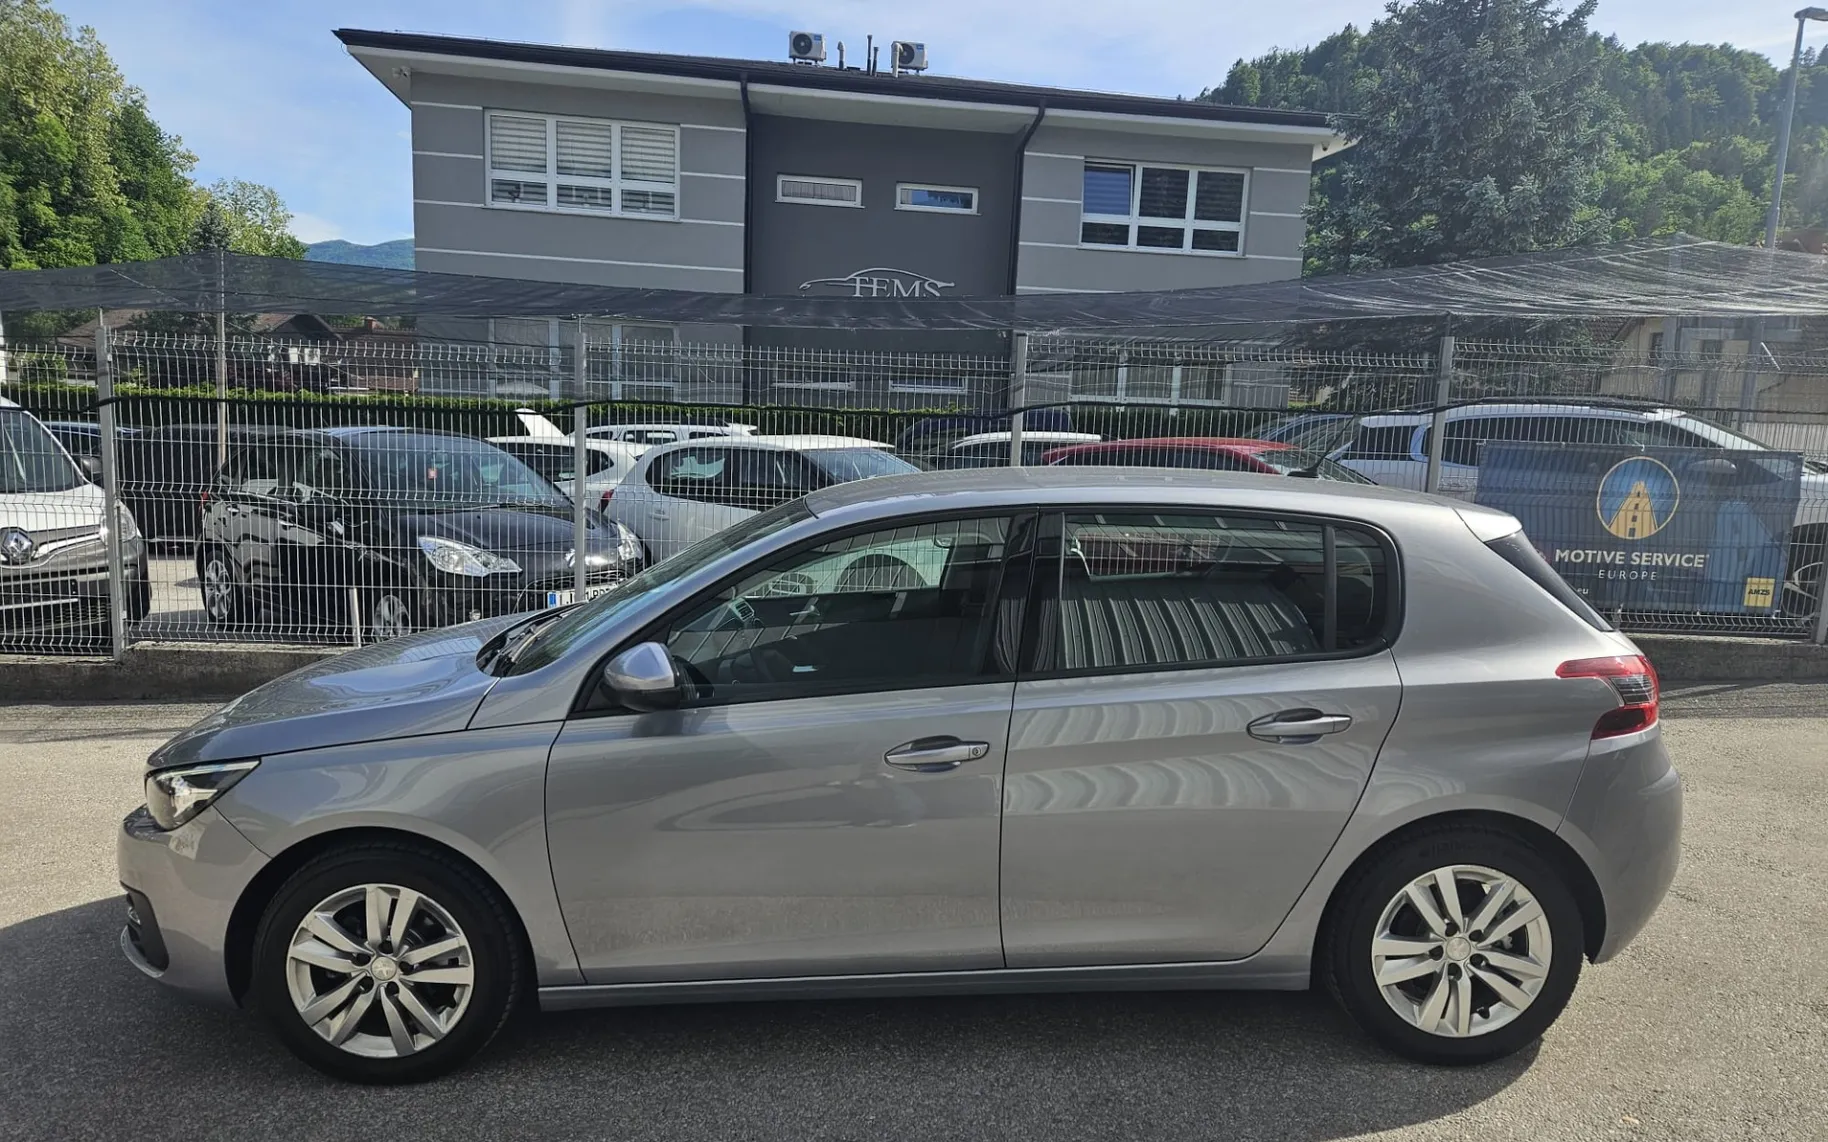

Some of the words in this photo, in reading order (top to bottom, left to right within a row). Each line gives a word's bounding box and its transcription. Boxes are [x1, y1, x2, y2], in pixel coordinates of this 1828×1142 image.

[852, 276, 941, 297] TEMS
[1555, 549, 1625, 564] MOTIVE
[1630, 551, 1705, 568] SERVICE
[1598, 569, 1657, 581] EUROPE
